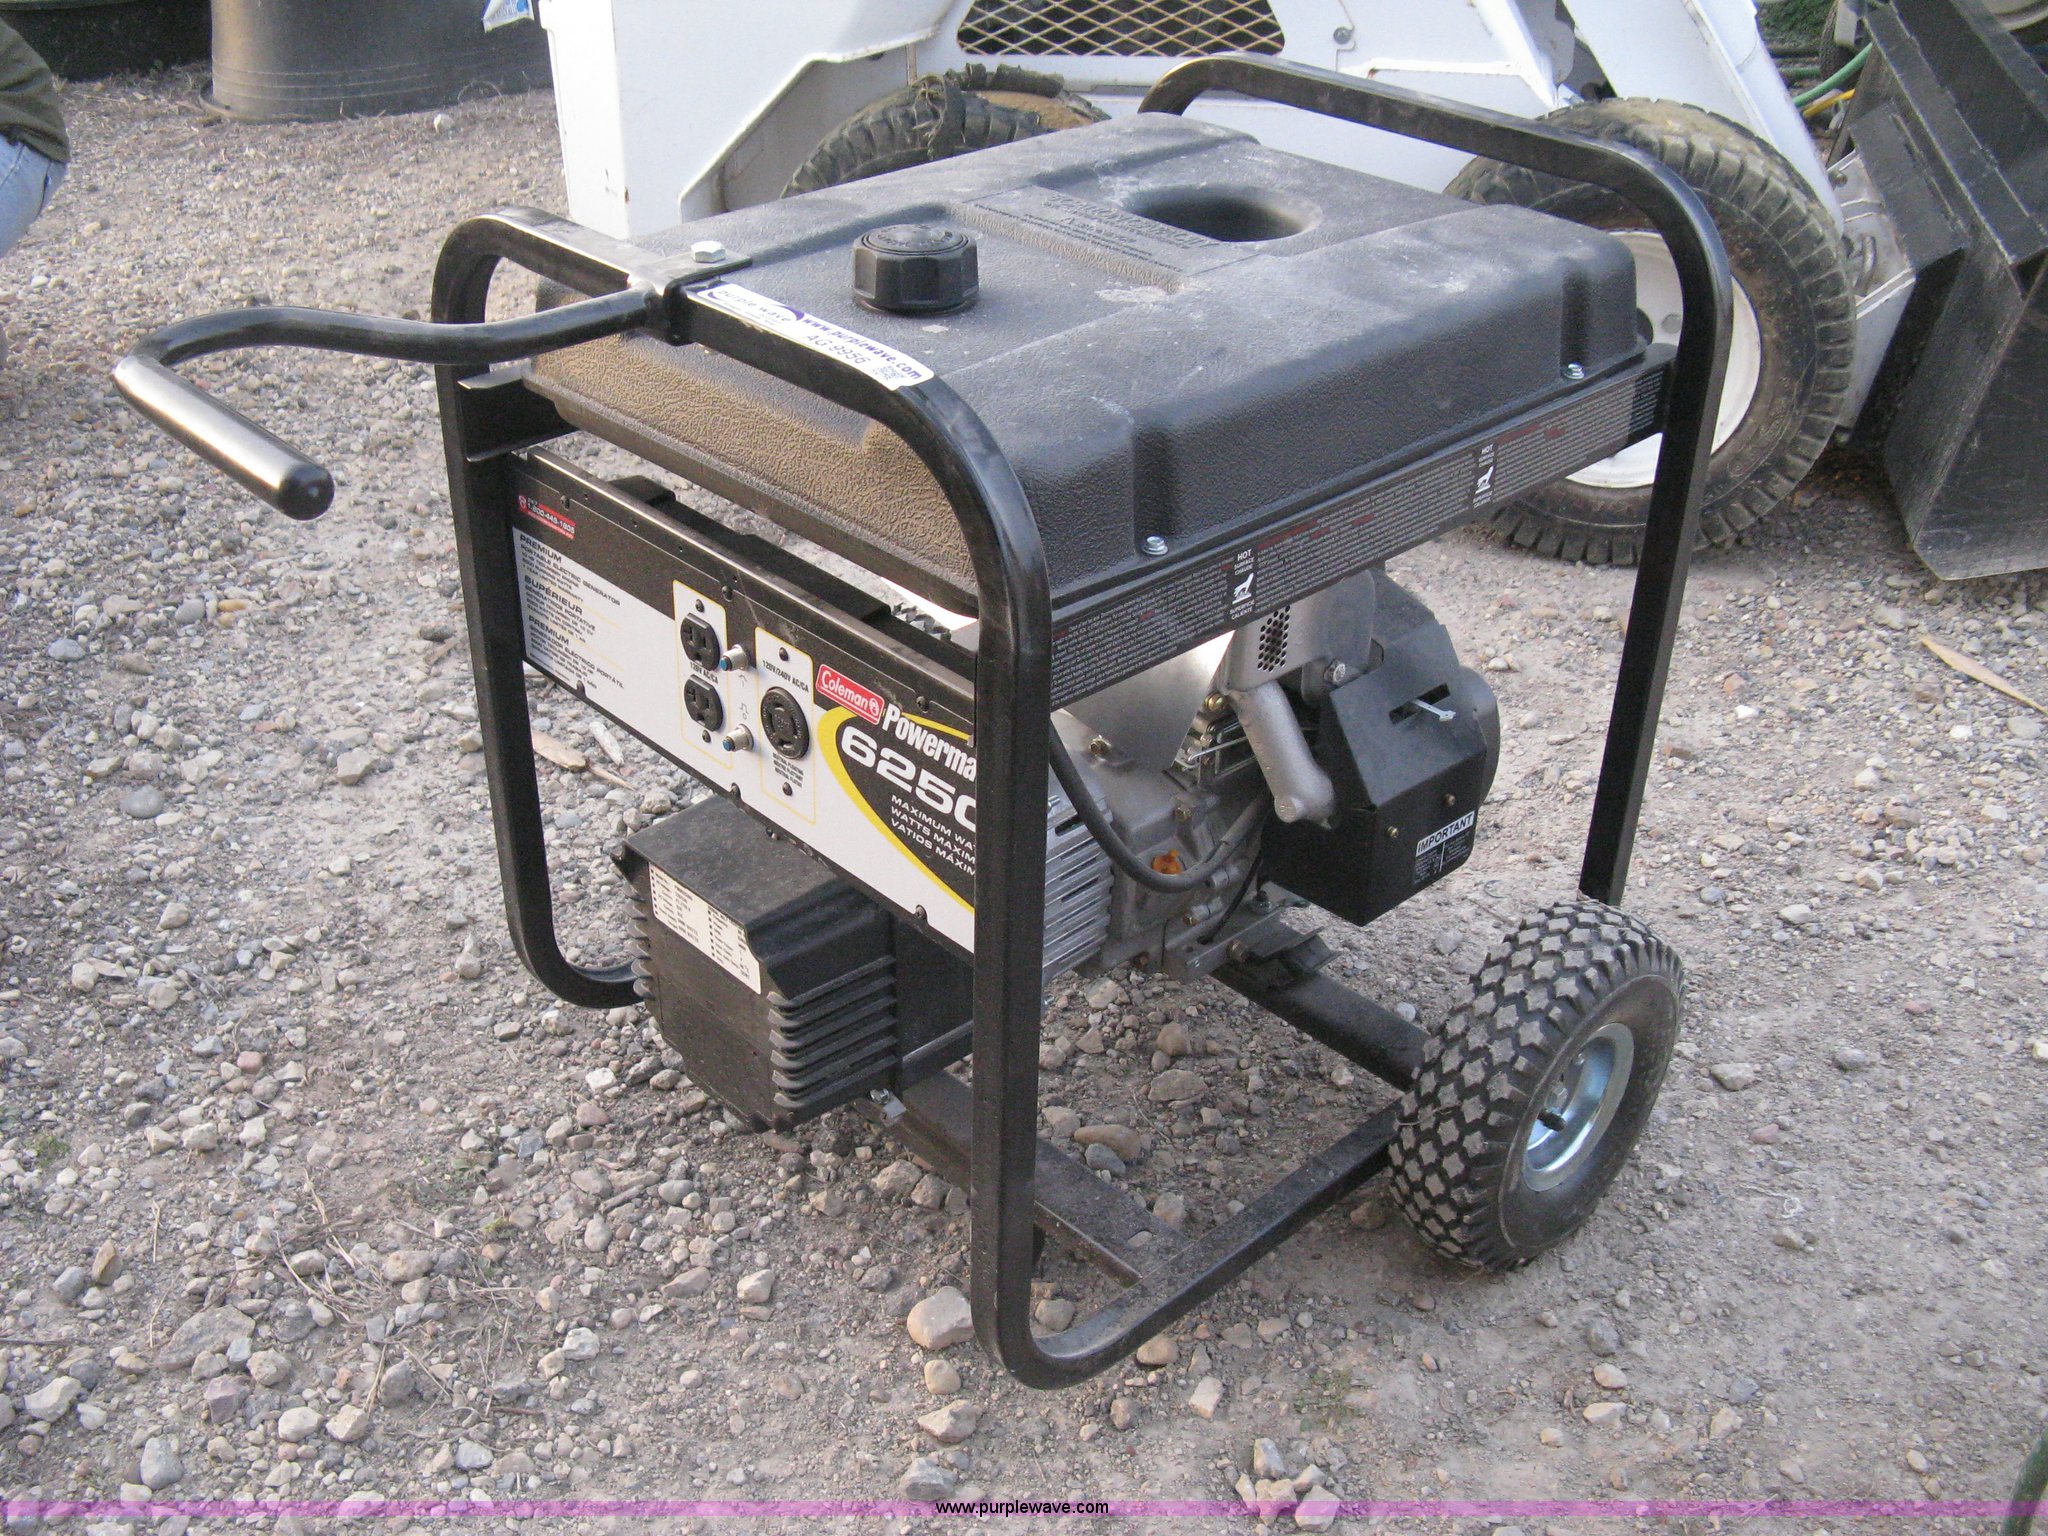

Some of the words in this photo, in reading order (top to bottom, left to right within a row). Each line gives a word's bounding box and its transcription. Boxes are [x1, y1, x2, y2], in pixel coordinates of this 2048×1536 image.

[802, 318, 923, 380] www.purplewave.com
[520, 534, 562, 563] PREMIUM
[1237, 548, 1252, 561] HOT
[524, 574, 583, 616] SUPÉRIEUR
[582, 579, 621, 606] GENERATOR
[528, 614, 570, 646] PREMIUM
[690, 661, 703, 675] 120V
[703, 669, 719, 684] AC/CA
[762, 660, 792, 682] 120V/240V
[791, 677, 810, 693] AC/CA
[821, 669, 869, 711] Coleman
[891, 806, 931, 836] WATTS
[892, 794, 952, 837] MAXIMUM
[891, 818, 933, 850] VATIOS
[1417, 812, 1474, 854] IMPORTANT
